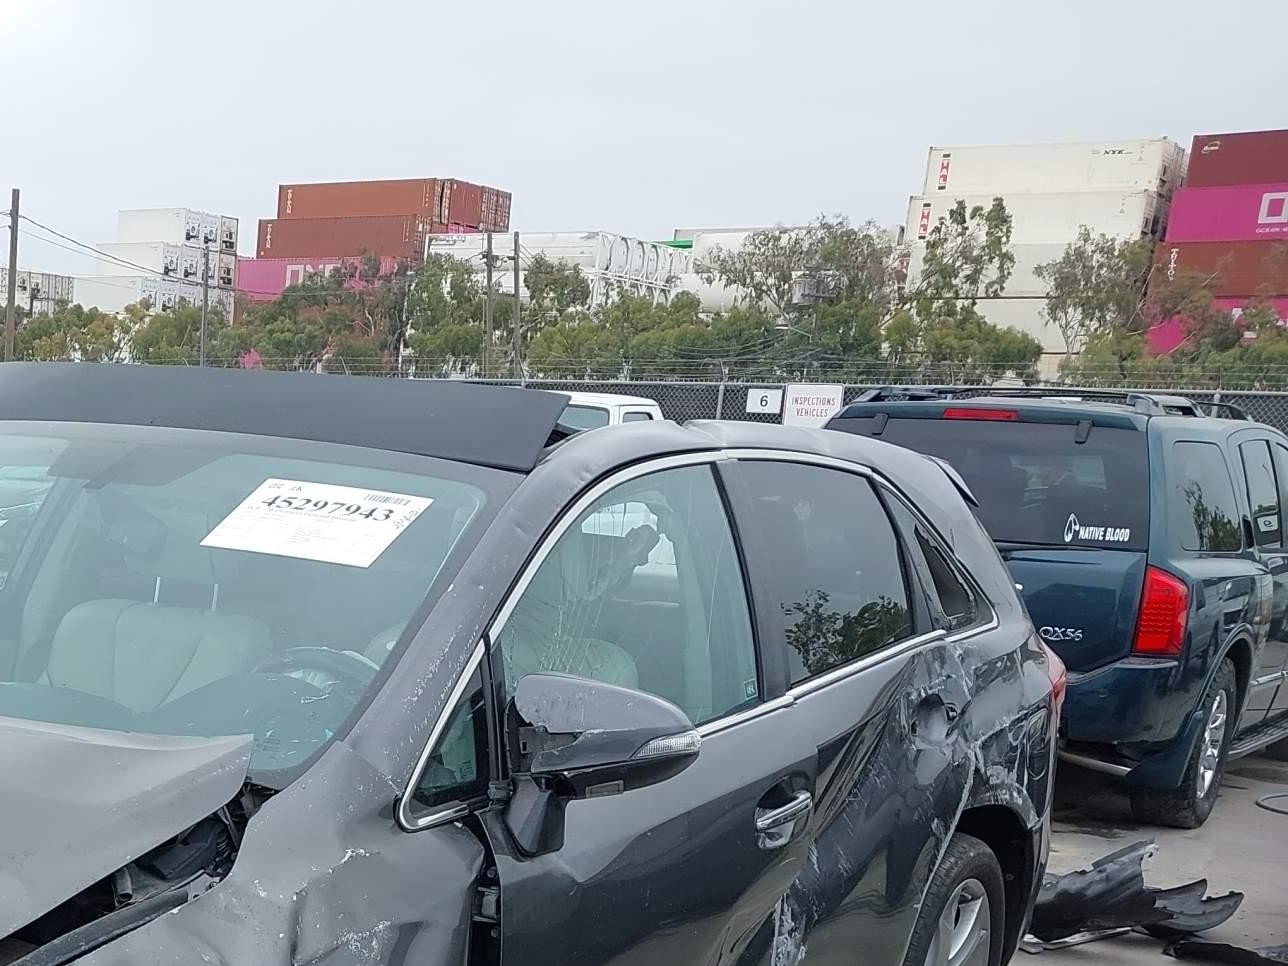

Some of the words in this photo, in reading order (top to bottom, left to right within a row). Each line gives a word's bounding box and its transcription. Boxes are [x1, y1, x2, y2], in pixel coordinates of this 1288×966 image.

[759, 395, 769, 407] 6
[791, 396, 836, 406] INSPECTIONS
[796, 408, 829, 417] VEHICLES
[261, 494, 395, 522] 45297943
[1078, 526, 1105, 540] NATIVE
[1105, 527, 1130, 541] BLOOD
[1038, 626, 1084, 641] QX56
